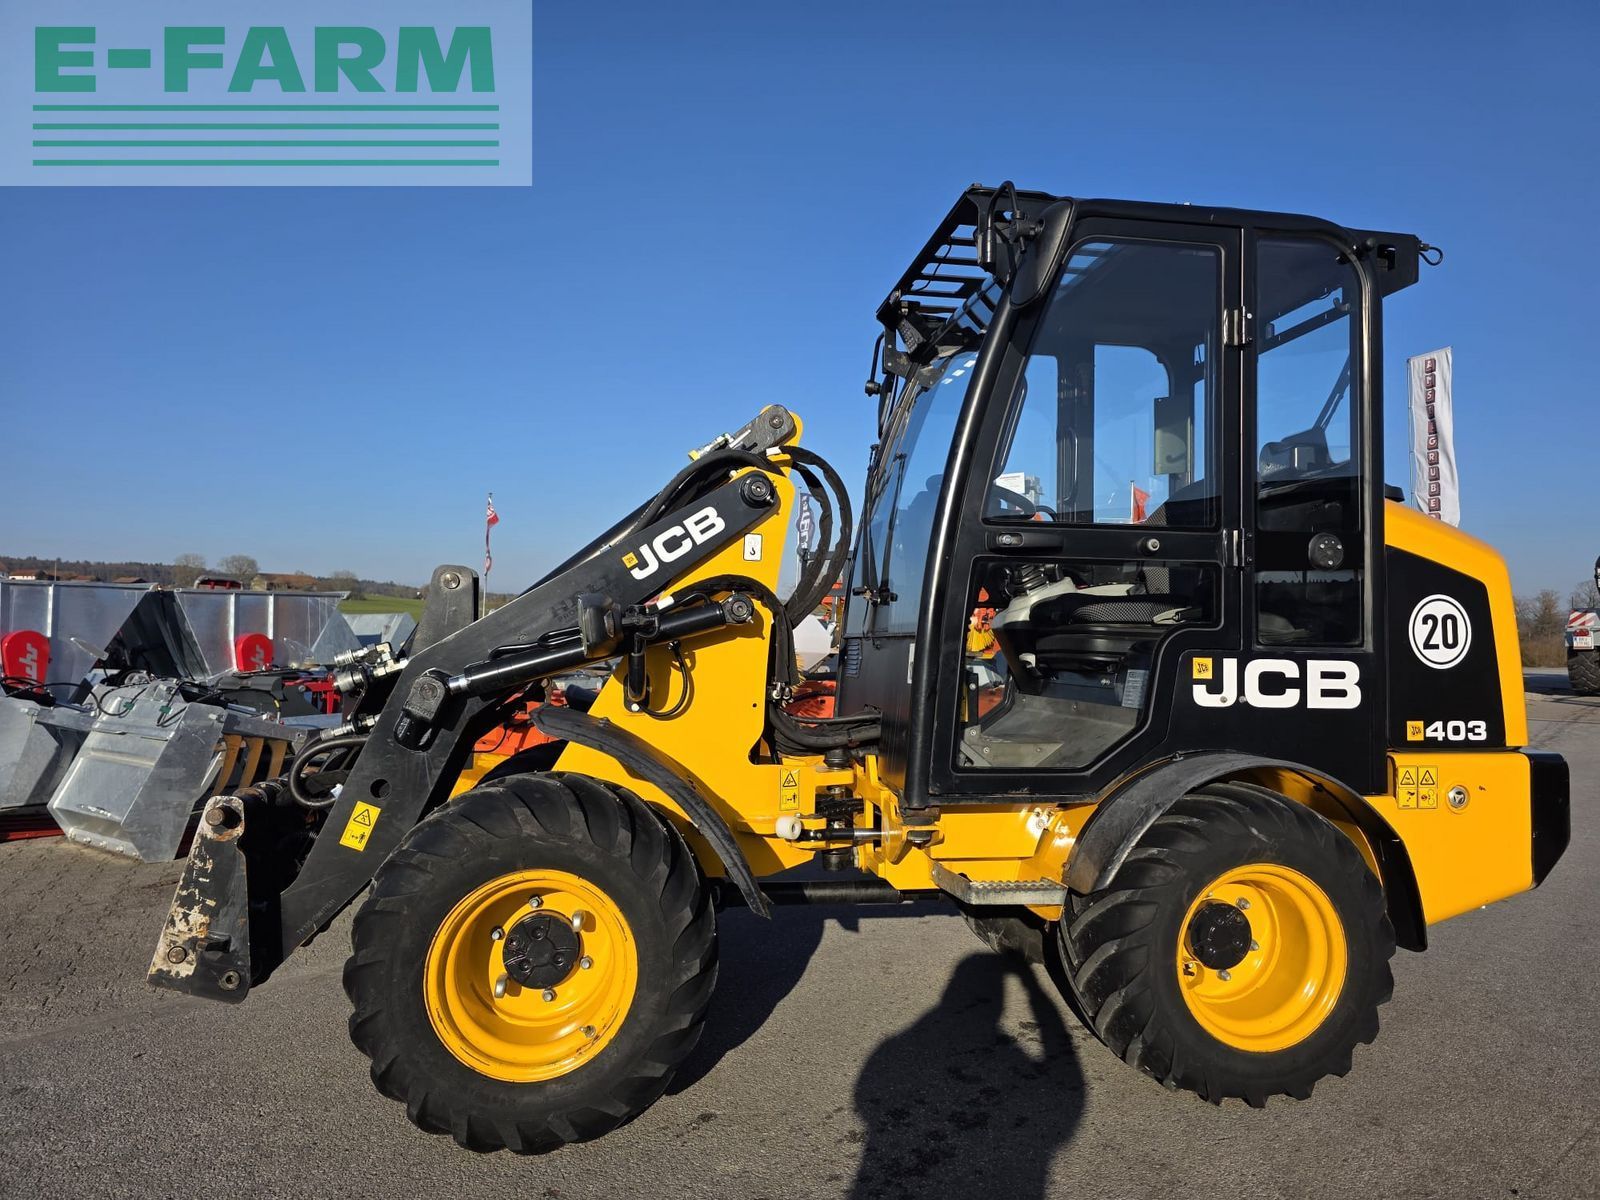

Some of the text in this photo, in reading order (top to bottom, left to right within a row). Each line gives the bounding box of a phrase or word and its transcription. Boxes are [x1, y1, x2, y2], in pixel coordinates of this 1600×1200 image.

[630, 506, 726, 580] JCB
[1421, 613, 1459, 650] 20
[1192, 657, 1361, 709] JCB
[1425, 720, 1487, 741] 403
